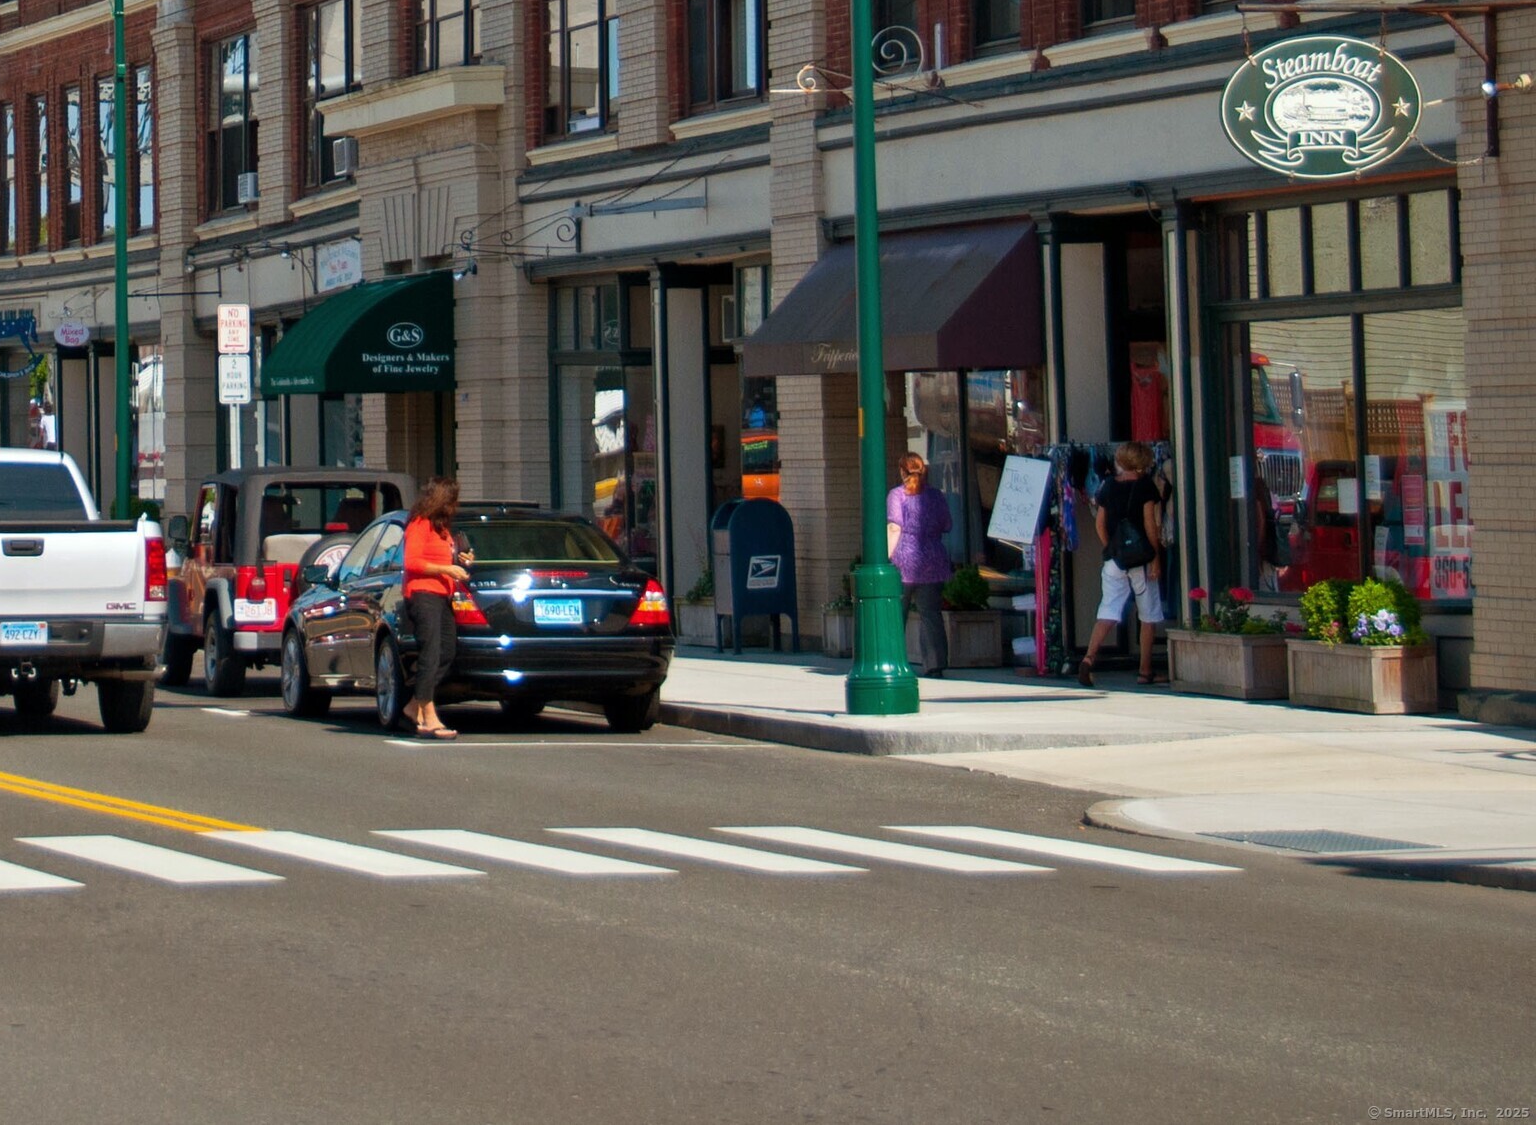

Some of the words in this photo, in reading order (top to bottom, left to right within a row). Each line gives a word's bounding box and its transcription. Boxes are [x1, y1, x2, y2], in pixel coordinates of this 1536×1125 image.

[1262, 43, 1382, 90] Steamboat
[1298, 130, 1346, 146] INN
[228, 308, 239, 318] NO
[221, 320, 247, 328] PARKING
[60, 327, 84, 335] Mixed
[389, 327, 421, 343] G&S
[65, 335, 80, 344] Bag
[362, 353, 404, 363] Designers
[406, 353, 414, 362] &
[416, 352, 450, 362] Makers
[231, 358, 238, 370] 2
[372, 365, 383, 373] of
[383, 364, 402, 373] Fine
[405, 364, 439, 375] Jewelry
[222, 382, 247, 390] PARKING
[106, 602, 137, 611] GMC
